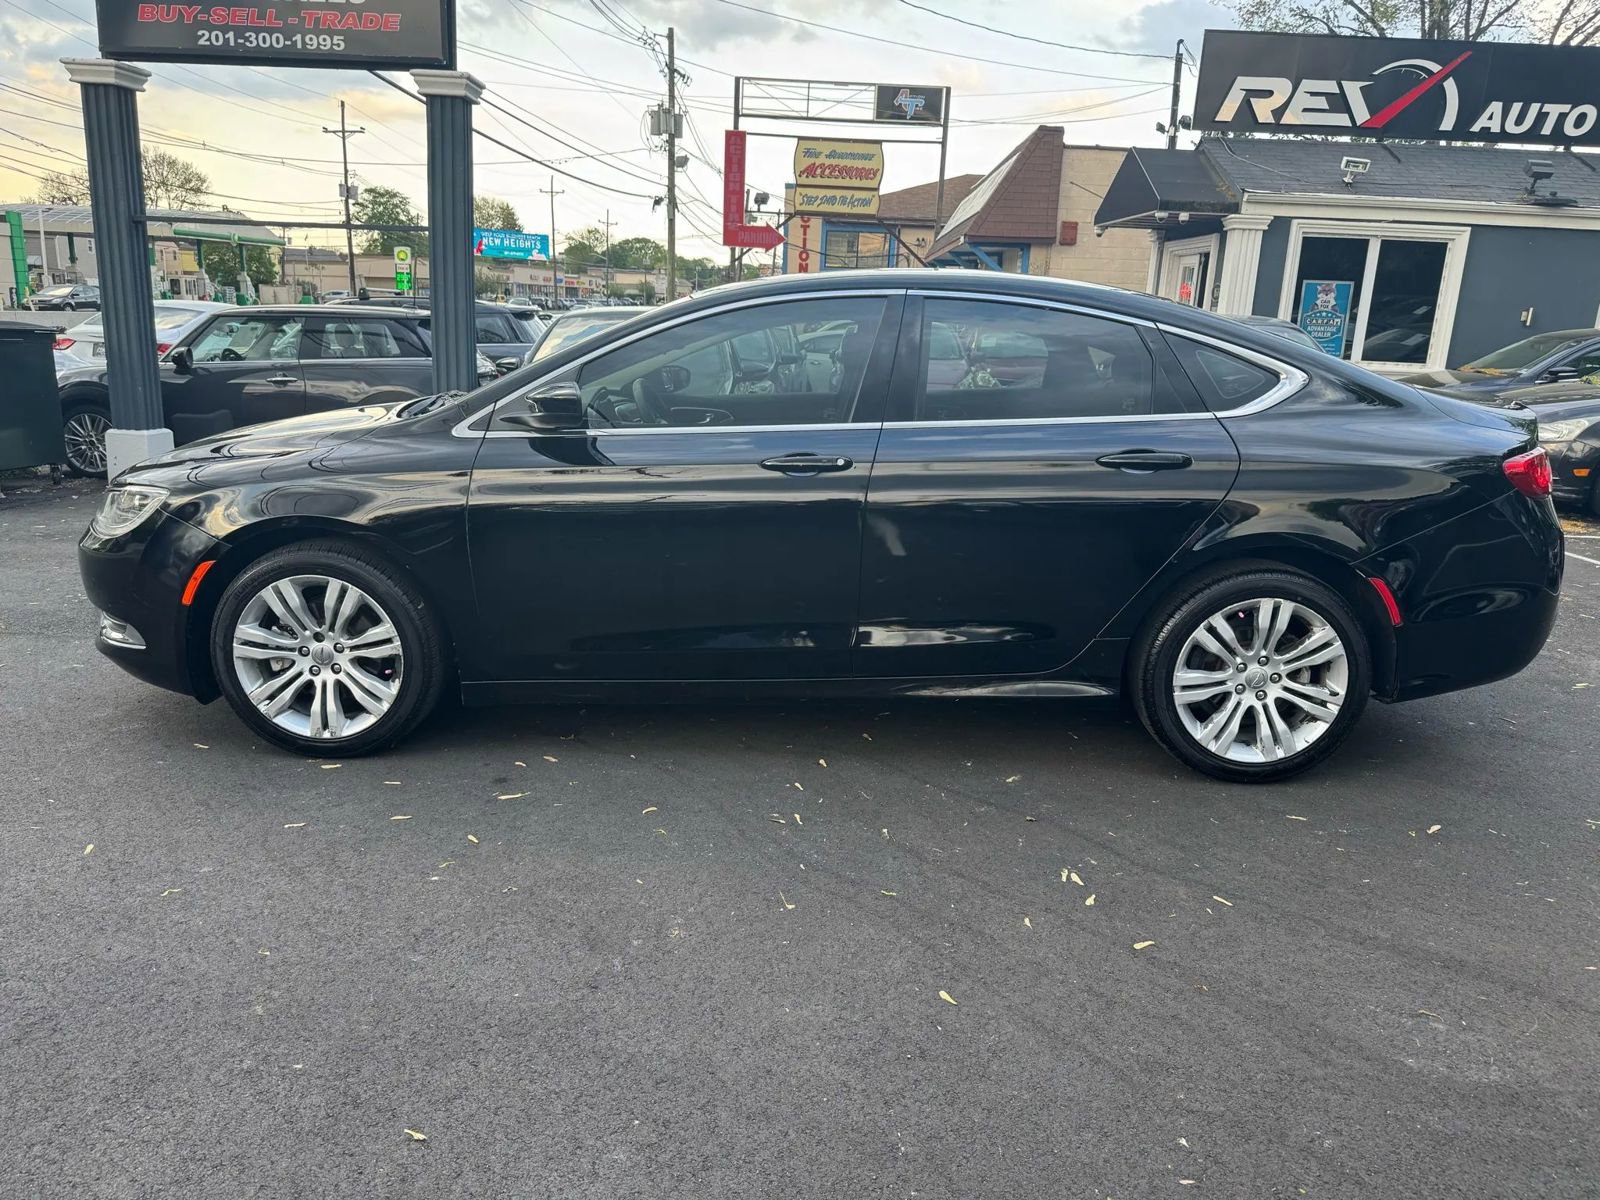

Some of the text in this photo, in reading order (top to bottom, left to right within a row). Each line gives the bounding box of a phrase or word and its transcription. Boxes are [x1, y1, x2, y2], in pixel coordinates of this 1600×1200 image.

[197, 30, 346, 51] 201-300-1995
[1469, 101, 1599, 137] AUTO
[728, 136, 742, 192] ACTION
[798, 162, 880, 181] ACCESSORIES
[482, 237, 541, 249] NEW HEIGHTS
[738, 231, 779, 244] PARKING
